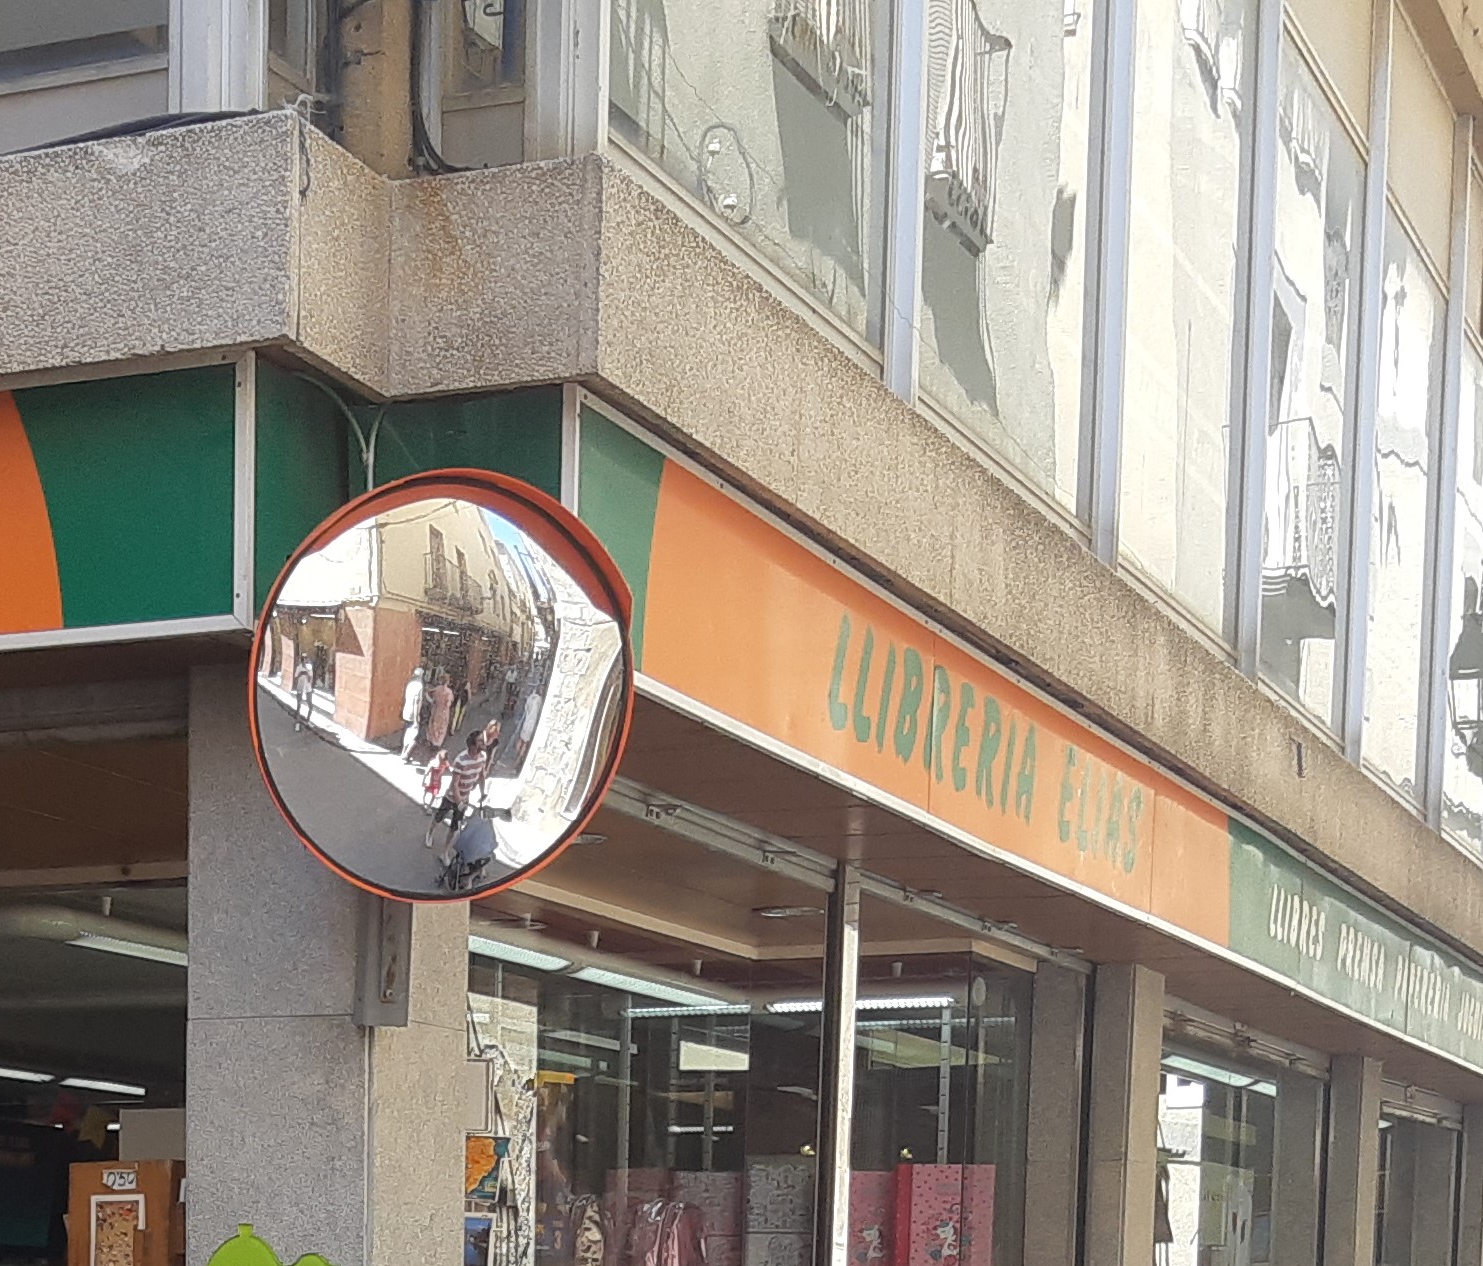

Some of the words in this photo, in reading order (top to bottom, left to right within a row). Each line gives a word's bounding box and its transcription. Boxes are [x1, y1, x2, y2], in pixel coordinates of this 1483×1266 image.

[828, 612, 1037, 826] LLIBRERIA
[1057, 745, 1145, 874] ELIAS
[1269, 884, 1326, 961] LLIBRES
